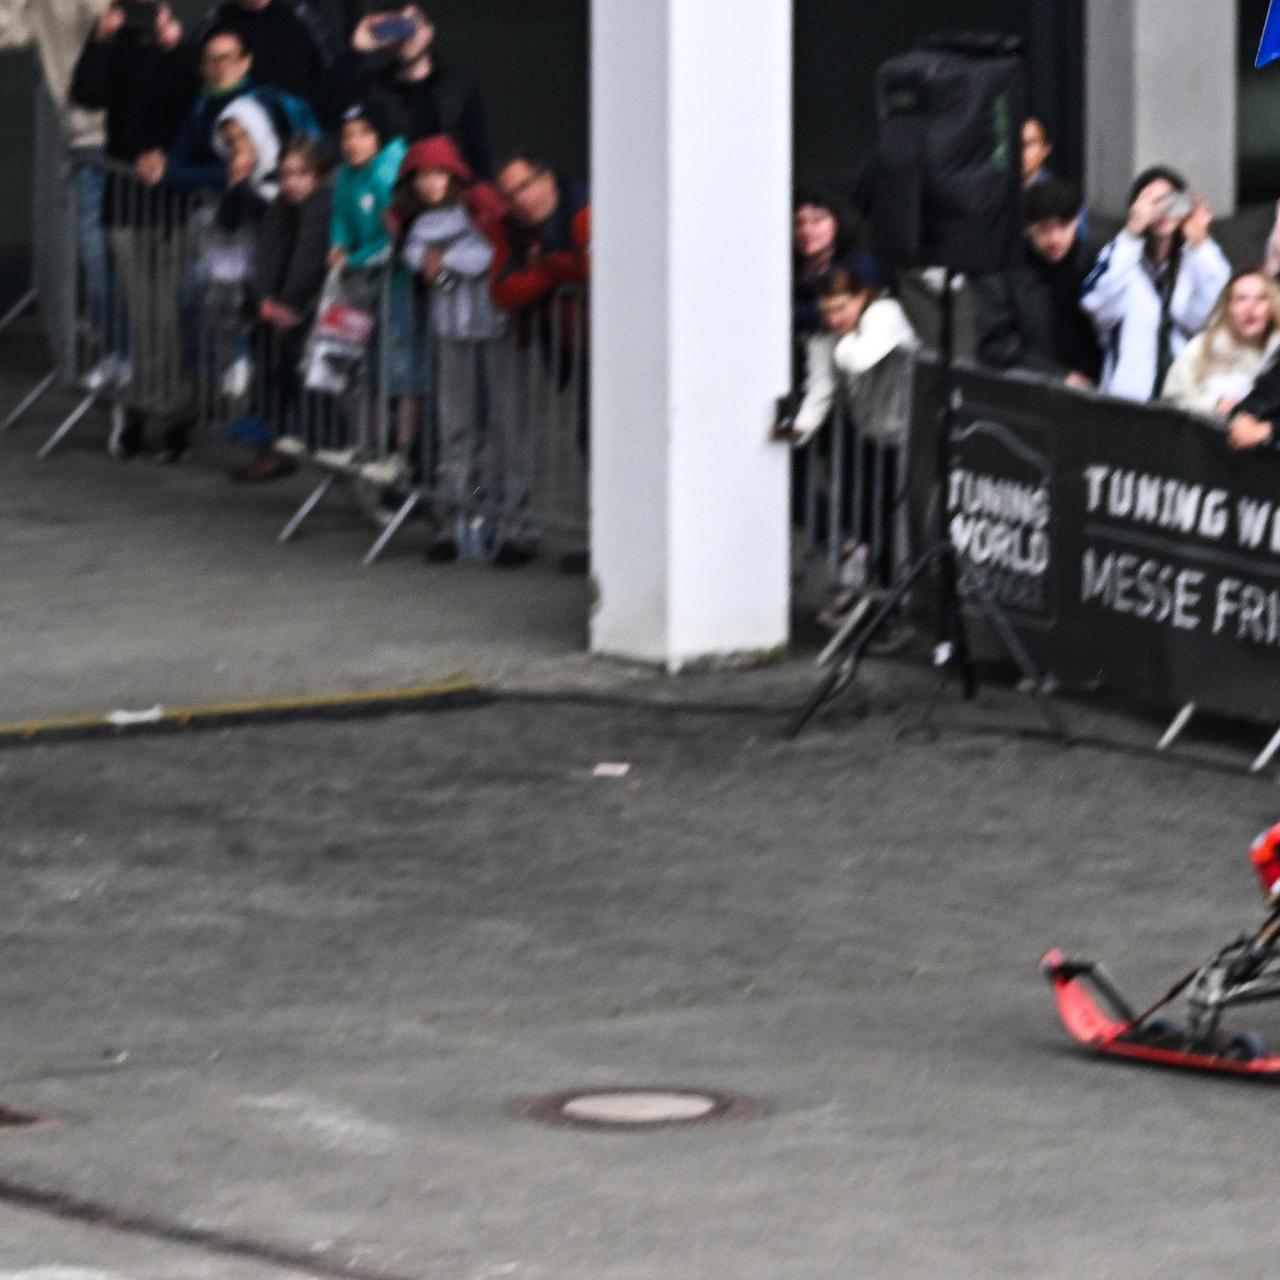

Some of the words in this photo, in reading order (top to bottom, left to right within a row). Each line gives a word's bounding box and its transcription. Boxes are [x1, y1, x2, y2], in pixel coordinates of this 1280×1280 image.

[1085, 465, 1229, 539] TUNING
[949, 512, 1049, 577] WORLD
[1081, 548, 1202, 630] MESSE
